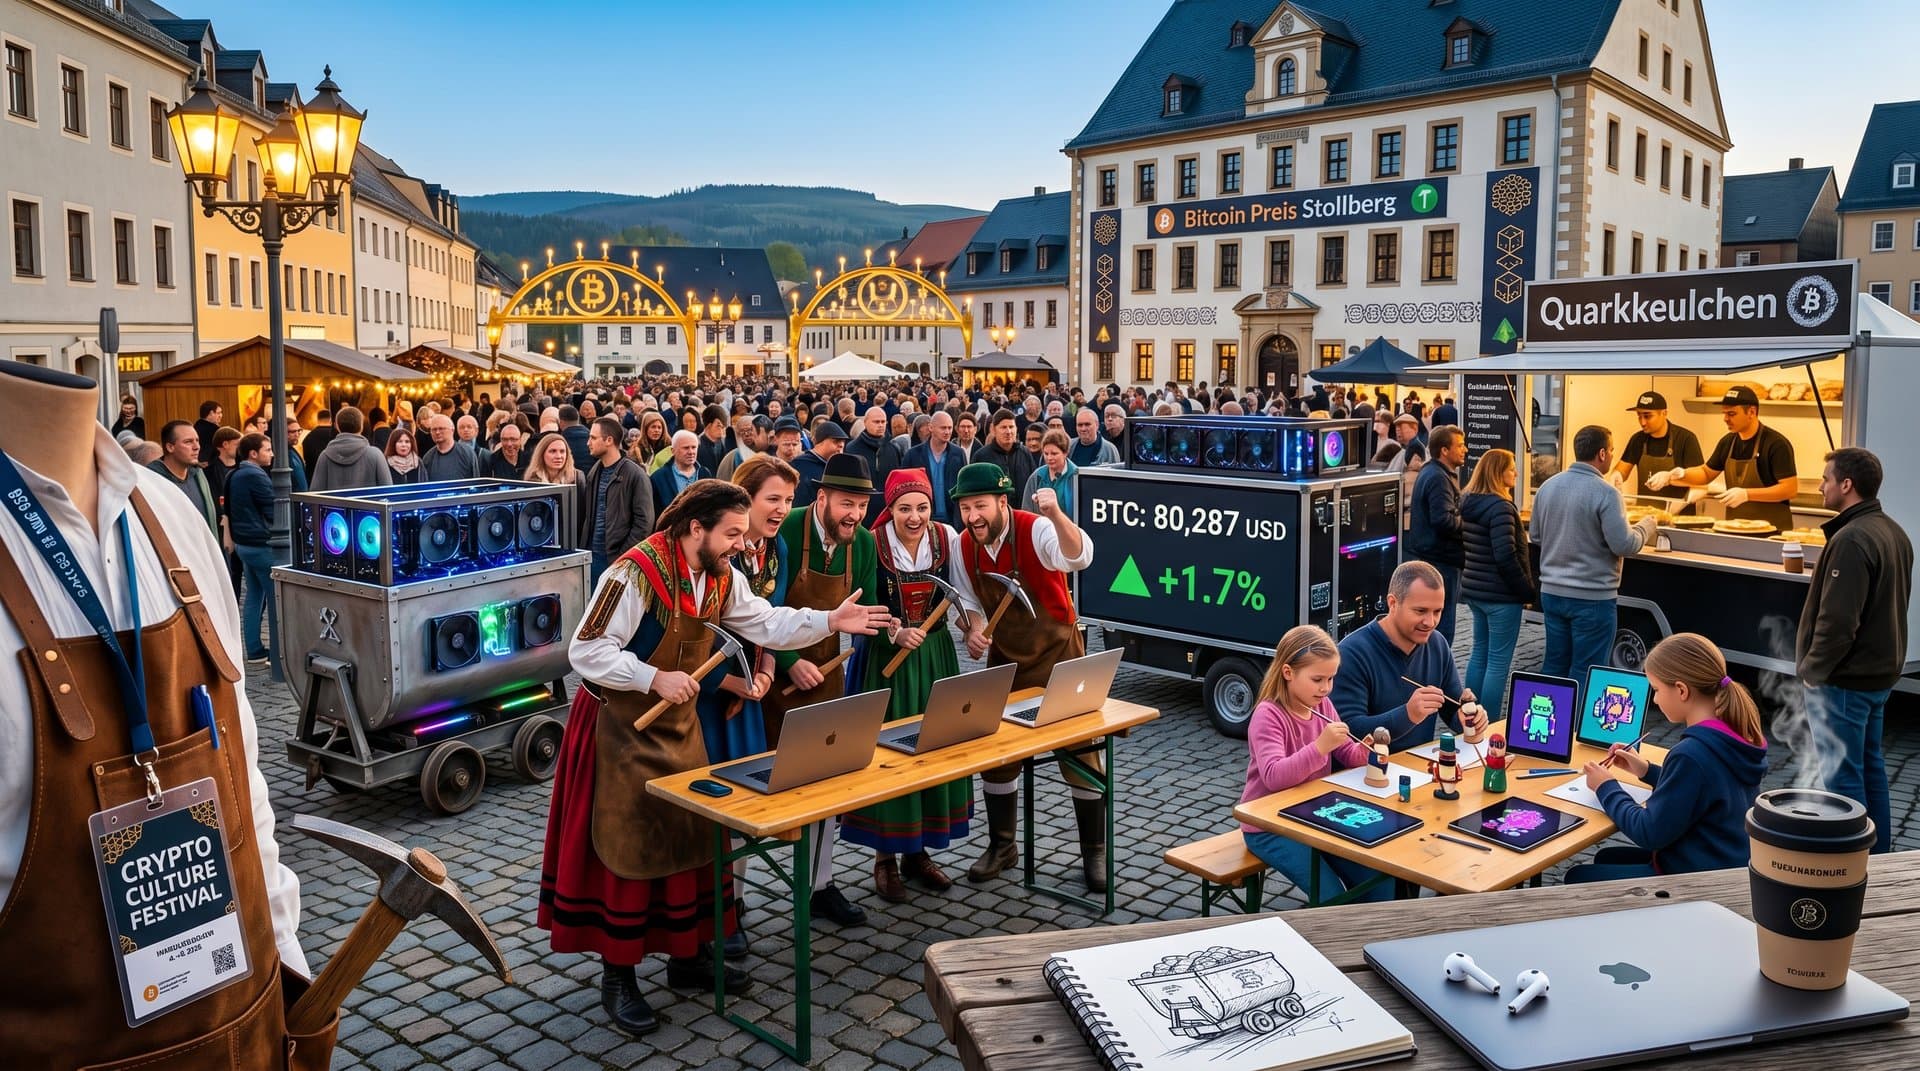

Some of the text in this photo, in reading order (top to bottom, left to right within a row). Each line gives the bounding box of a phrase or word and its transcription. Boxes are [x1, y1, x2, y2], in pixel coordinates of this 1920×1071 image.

[1185, 194, 1397, 228] Bitcoin Preis Stollberg
[1540, 288, 1776, 331] Quarkkeulchen
[1092, 498, 1287, 541] BTC: 80,287 USD
[1158, 565, 1266, 611] +1.7%
[121, 835, 212, 883] CRYPTO
[125, 859, 218, 906] CULTURE
[130, 883, 223, 931] FESTIVAL
